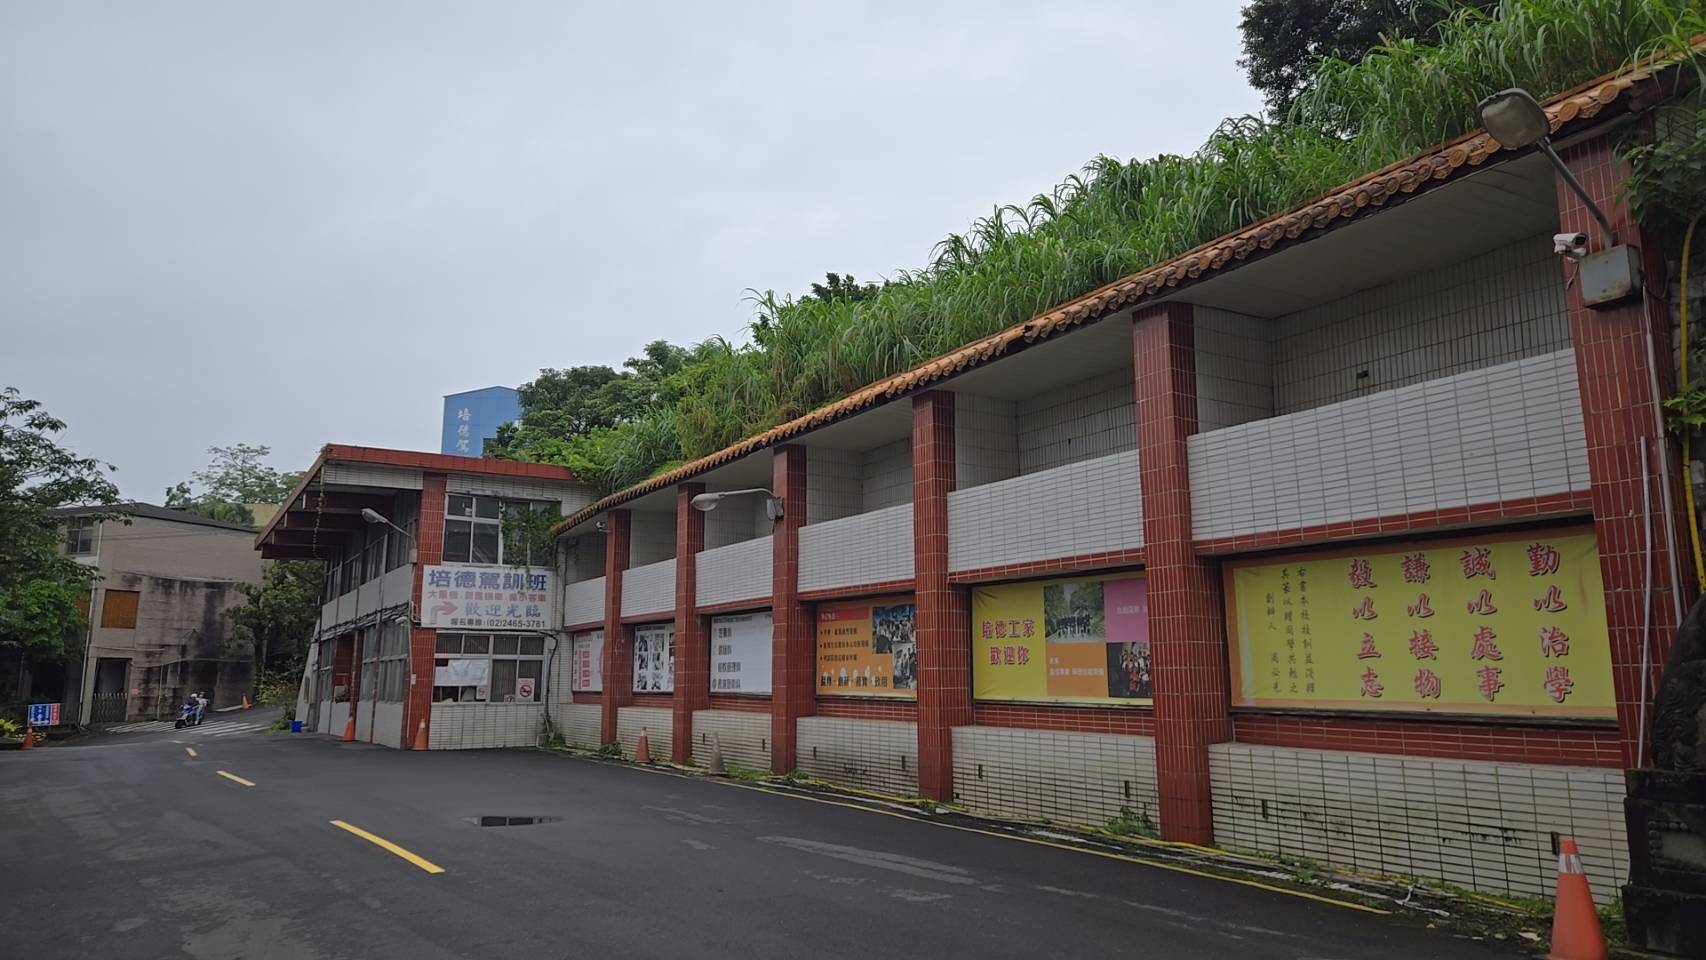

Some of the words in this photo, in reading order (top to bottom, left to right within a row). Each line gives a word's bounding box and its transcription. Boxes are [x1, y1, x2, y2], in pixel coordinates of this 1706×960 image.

[428, 569, 547, 591] 培德駕訓班
[465, 602, 541, 618] 歡迎光臨
[982, 618, 1036, 639] 培德工家
[1348, 558, 1385, 698] 毅以立志
[1401, 552, 1441, 699] 謙以接物
[1459, 547, 1505, 702] 誠以處事
[1526, 542, 1574, 703] 勤以治學
